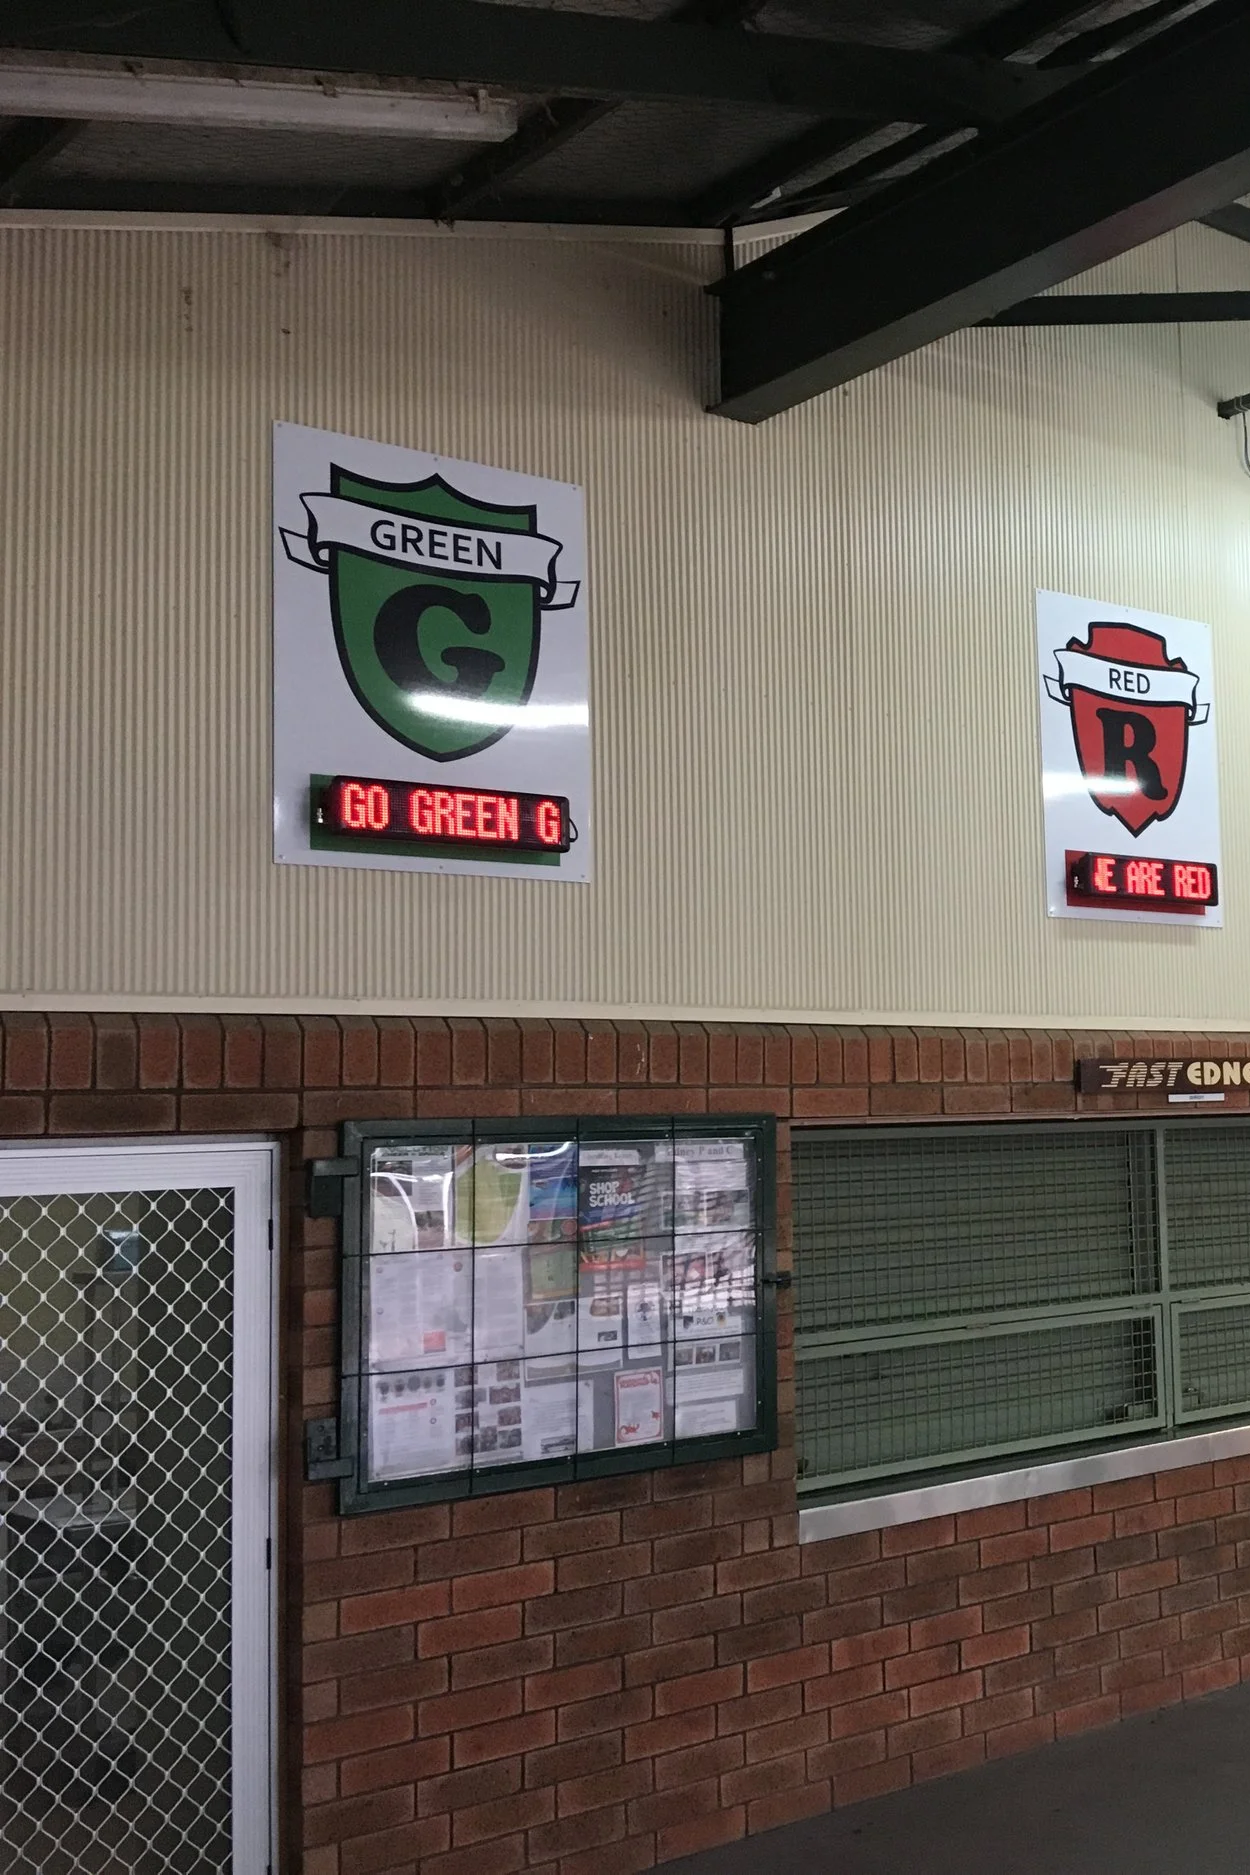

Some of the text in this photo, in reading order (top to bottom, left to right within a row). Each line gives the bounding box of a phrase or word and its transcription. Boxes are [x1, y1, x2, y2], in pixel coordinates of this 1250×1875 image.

[370, 519, 502, 570] GREEN
[373, 584, 506, 699] G
[1109, 667, 1151, 694] RED
[1096, 708, 1168, 801] R
[341, 783, 562, 844] GO GREEN G
[1126, 861, 1165, 896] ARE
[1173, 865, 1211, 899] RED
[1099, 1061, 1184, 1088] FAST
[589, 1181, 620, 1195] SHOP
[589, 1192, 635, 1207] SCHOOL
